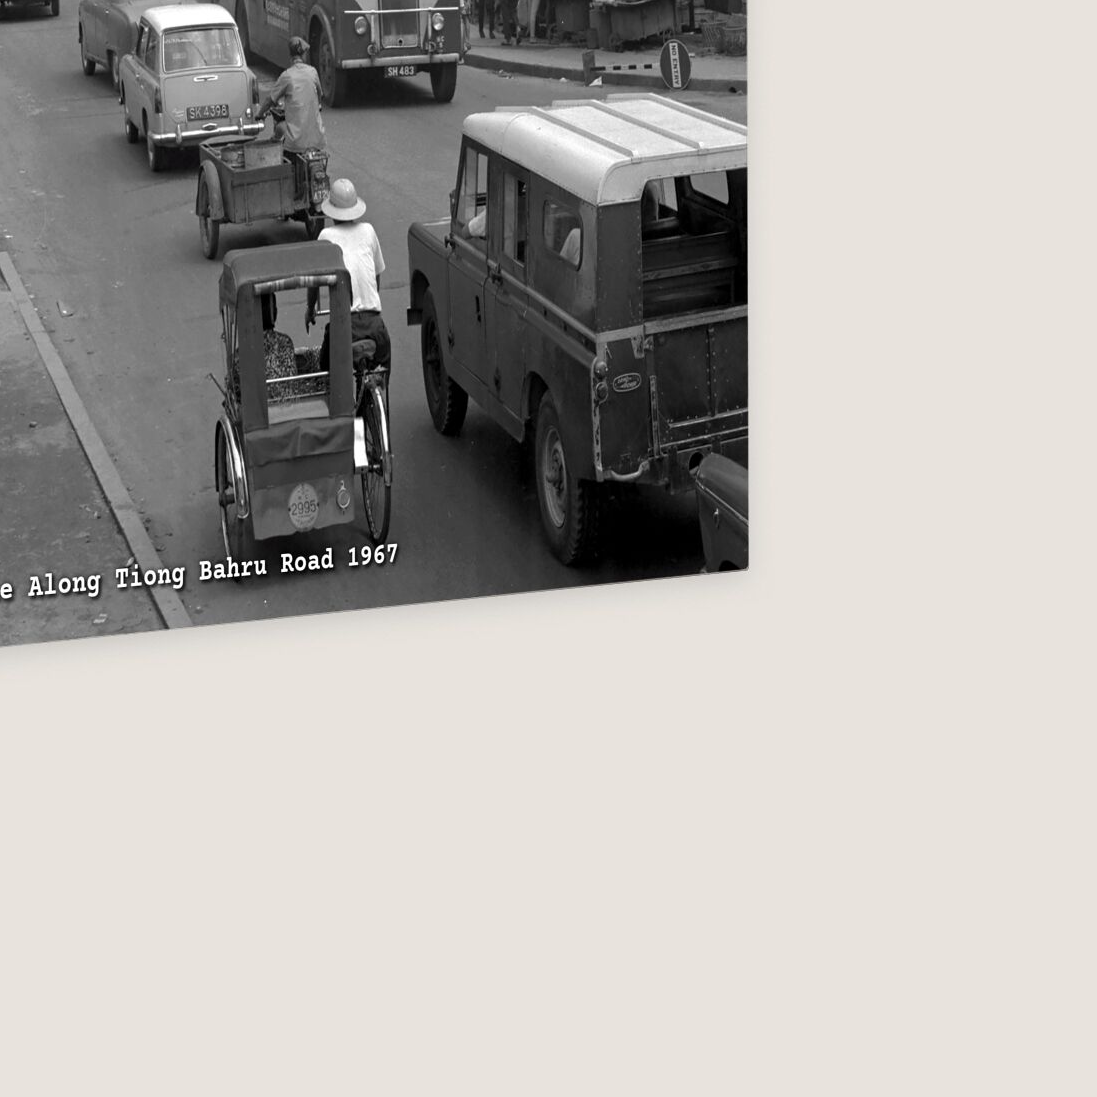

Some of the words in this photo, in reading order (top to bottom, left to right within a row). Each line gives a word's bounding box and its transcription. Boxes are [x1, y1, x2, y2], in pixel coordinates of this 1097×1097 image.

[671, 44, 677, 56] NO
[387, 66, 398, 76] SH
[399, 65, 414, 76] 483
[672, 58, 680, 85] ENTRY
[190, 107, 202, 119] SK
[203, 105, 227, 117] 4398
[292, 500, 317, 515] 2995
